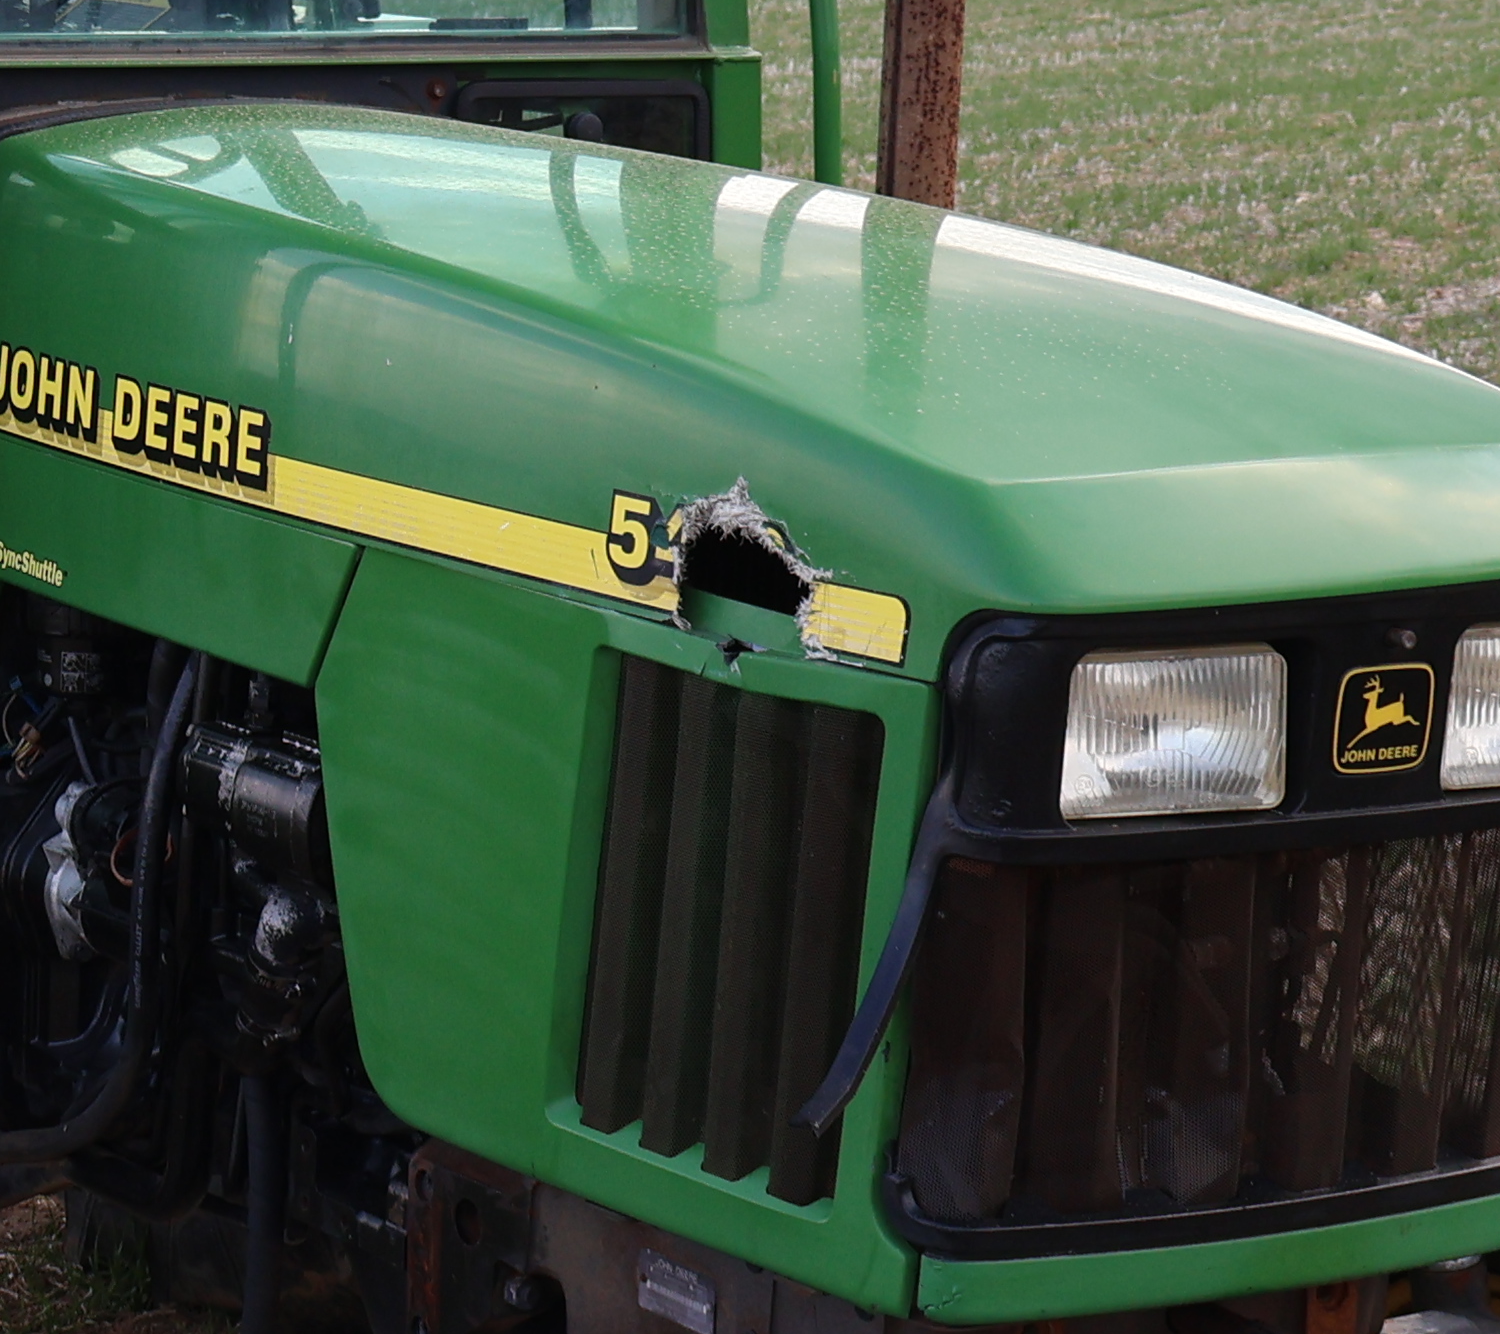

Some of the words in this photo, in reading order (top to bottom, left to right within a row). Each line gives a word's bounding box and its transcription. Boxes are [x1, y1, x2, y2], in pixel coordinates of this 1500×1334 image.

[112, 373, 271, 491] DEERE
[1340, 748, 1376, 764] JOHN
[1378, 744, 1419, 761] DEERE
